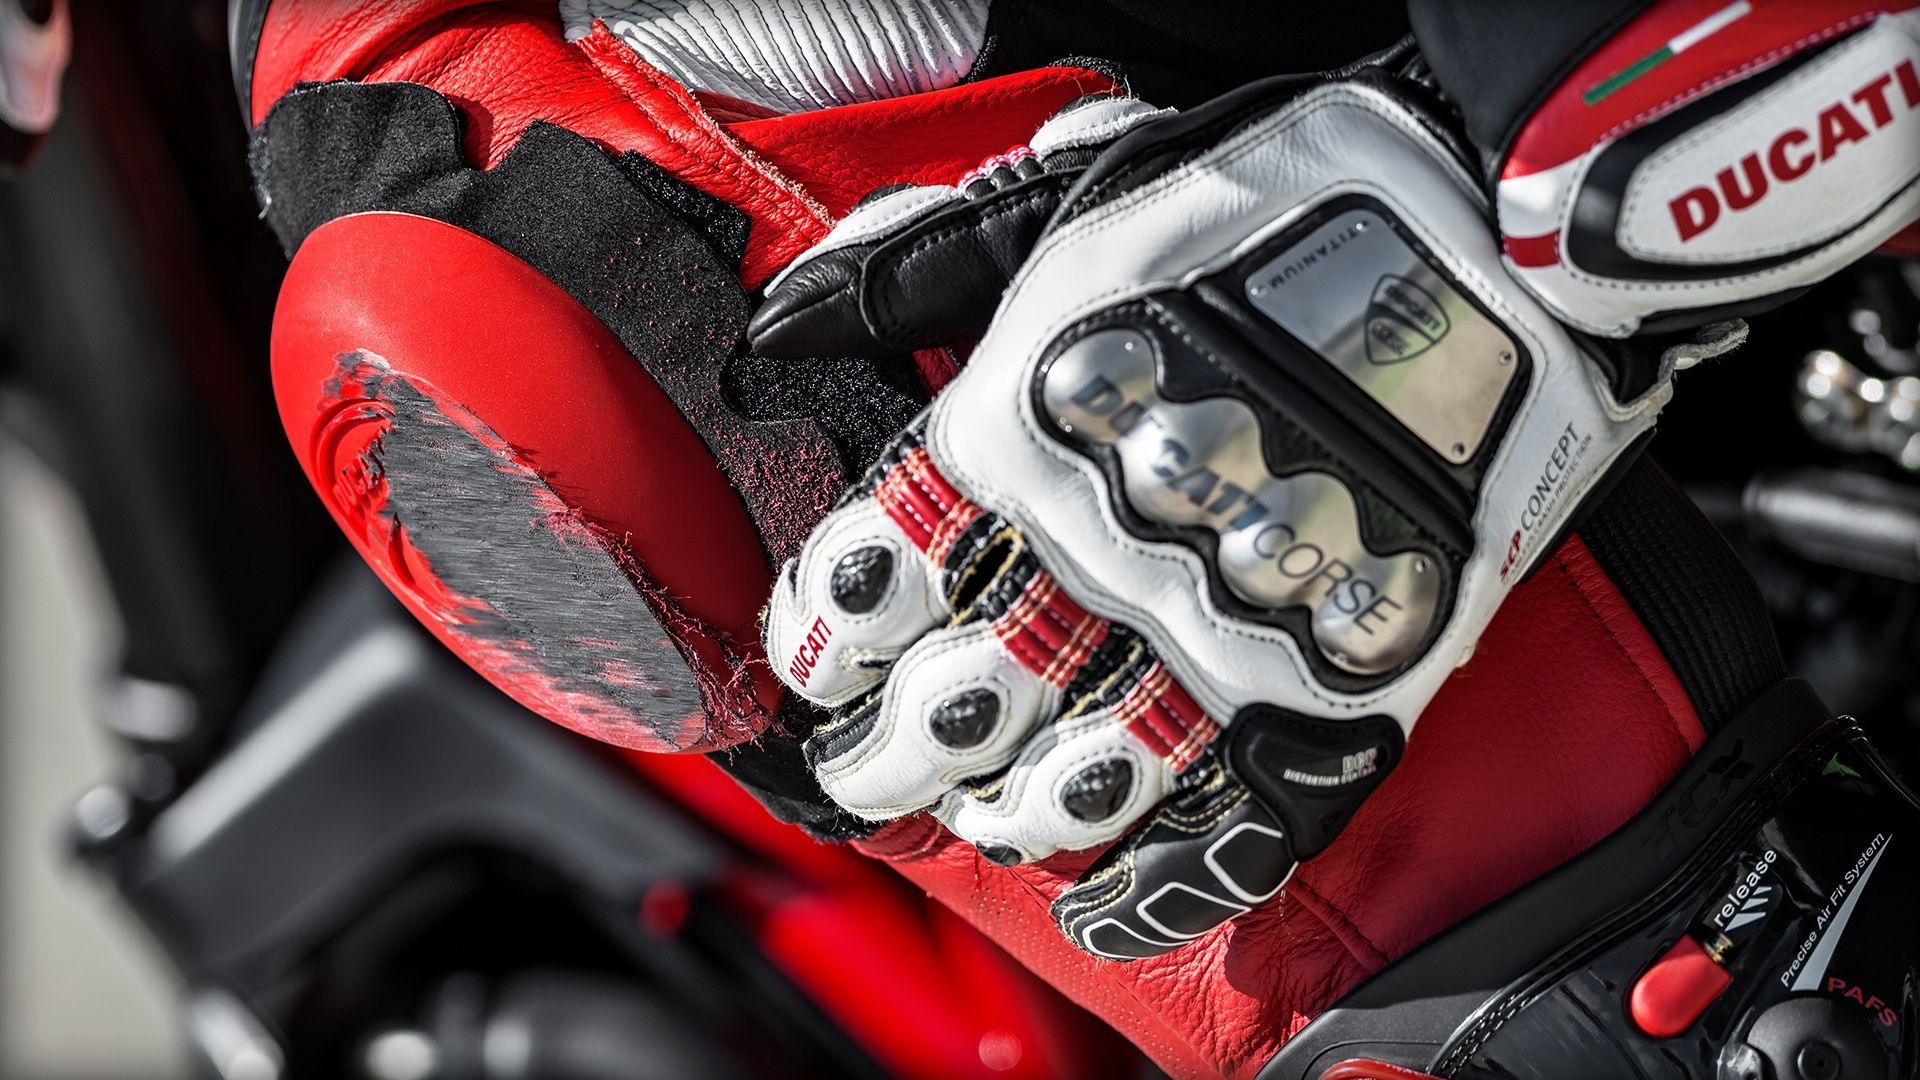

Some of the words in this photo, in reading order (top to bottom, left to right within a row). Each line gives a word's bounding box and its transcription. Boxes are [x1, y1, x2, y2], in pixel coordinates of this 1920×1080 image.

[1668, 57, 1920, 243] DUCATI
[1268, 228, 1359, 289] TITANIUM
[1500, 528, 1522, 582] SCP
[1520, 420, 1579, 532] CONCEPT
[1254, 523, 1403, 636] CORSE
[789, 614, 832, 689] DUCATI
[1712, 848, 1778, 929] release
[1780, 930, 1818, 988] Precise
[1816, 905, 1832, 931] Air
[1829, 884, 1847, 907] Fit
[1844, 832, 1886, 885] System
[1827, 976, 1898, 1027] PAFS
